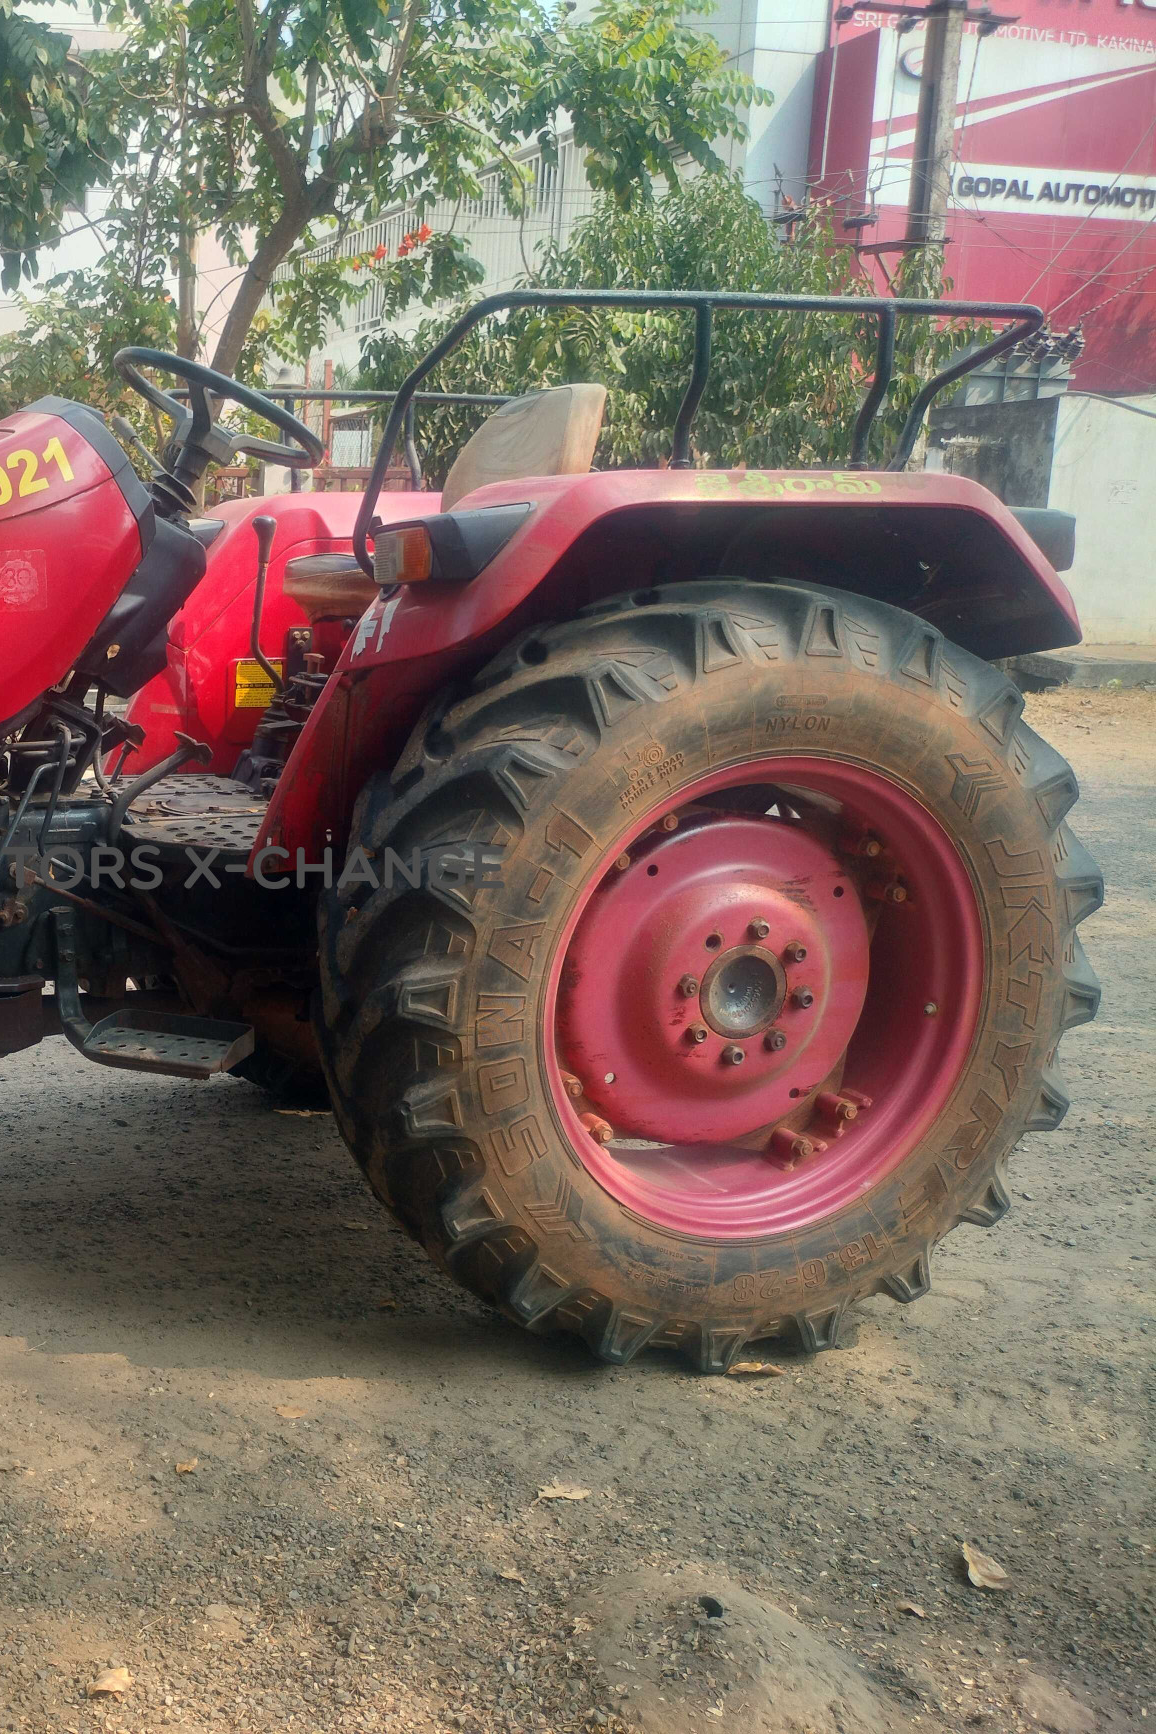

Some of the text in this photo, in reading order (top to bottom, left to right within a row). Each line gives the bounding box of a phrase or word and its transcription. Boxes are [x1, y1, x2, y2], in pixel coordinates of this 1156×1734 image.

[853, 11, 882, 28] SRI
[957, 176, 1034, 201] GOPAL
[765, 715, 831, 733] NYLON
[655, 752, 684, 773] ROAD
[659, 759, 685, 780] DUTY
[733, 1233, 885, 1304] 13.6-28
